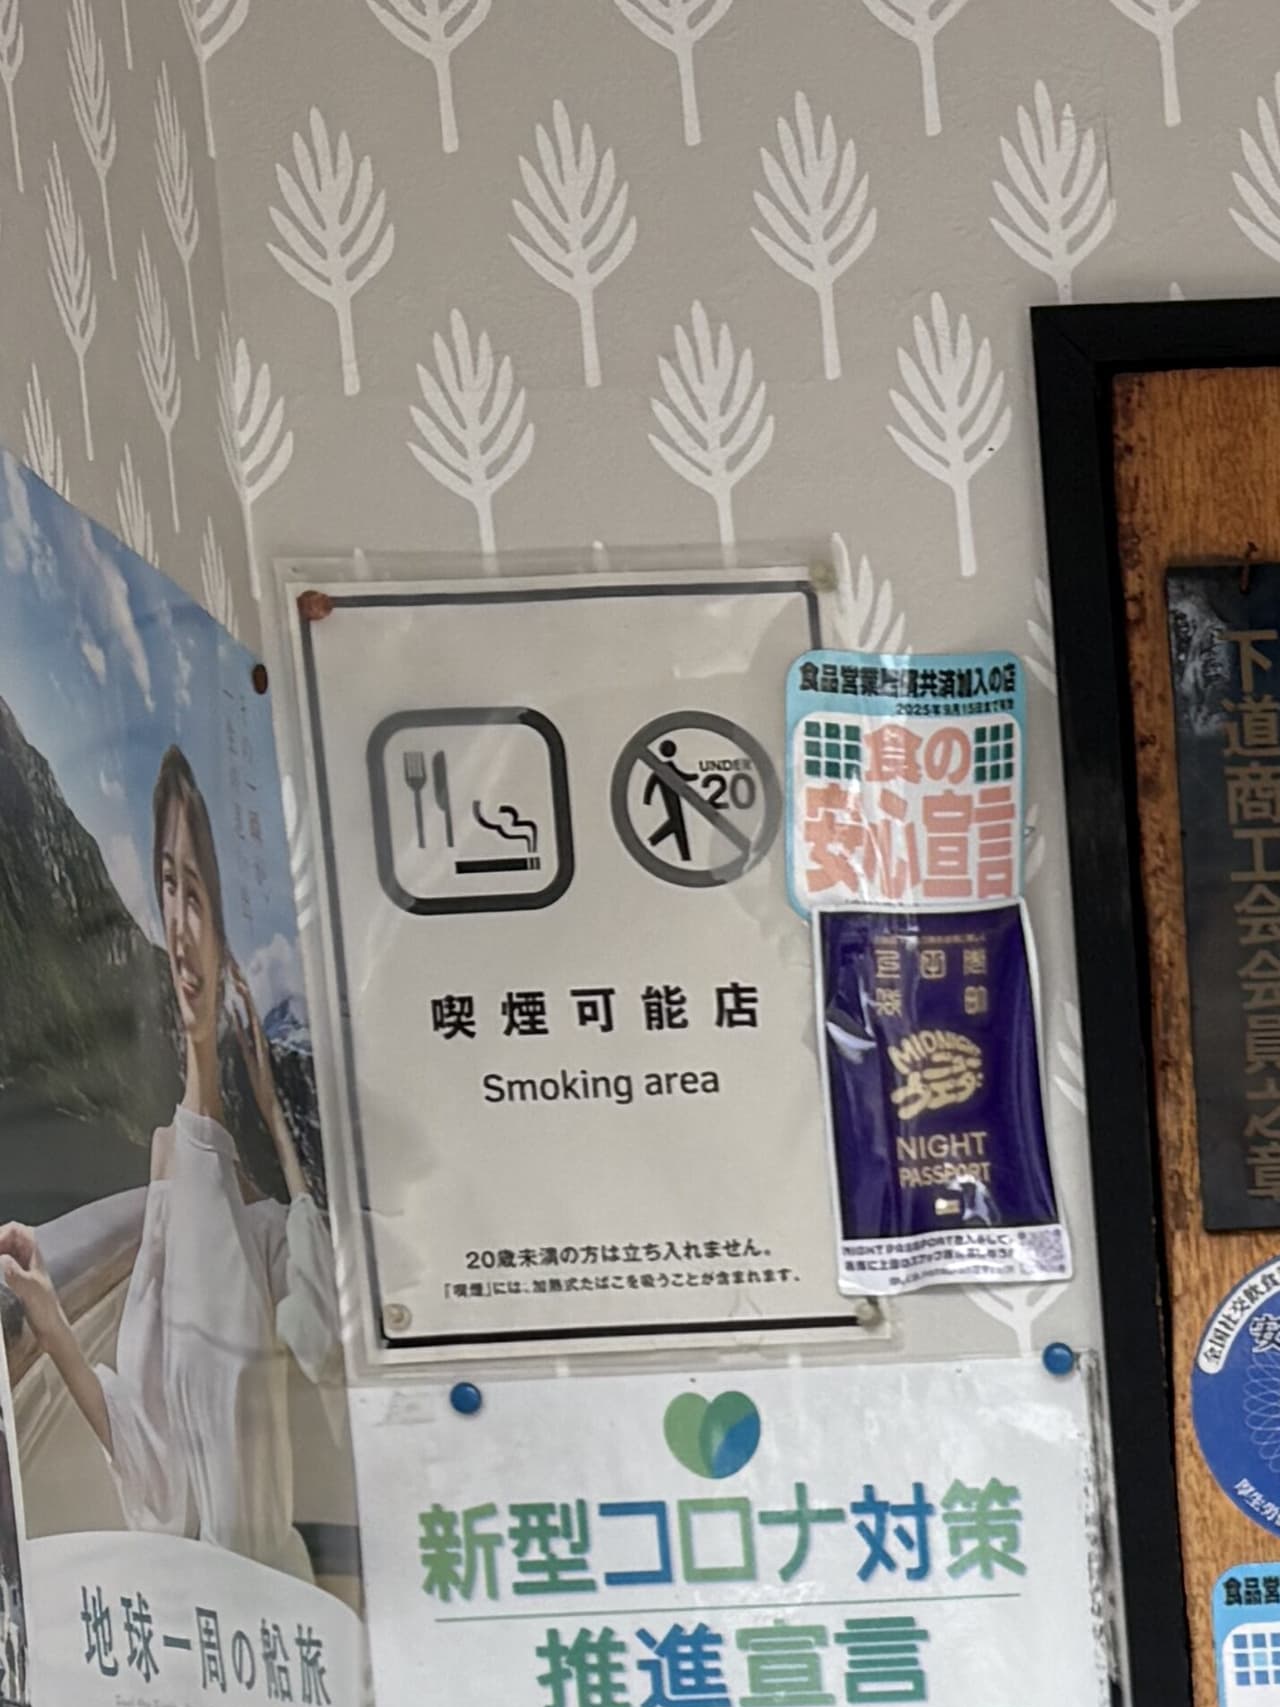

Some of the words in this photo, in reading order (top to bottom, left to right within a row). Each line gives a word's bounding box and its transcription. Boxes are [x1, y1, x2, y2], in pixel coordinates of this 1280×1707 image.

[863, 723, 972, 785] 食の
[702, 772, 757, 810] 20
[803, 783, 1016, 900] 安心宣言
[431, 982, 760, 1040] 喫煙可能店
[483, 1068, 634, 1104] Smoking
[644, 1068, 720, 1095] area
[896, 1132, 987, 1160] NIGHT
[899, 1162, 991, 1189] PASSPORT
[466, 1239, 772, 1270] 20歳未満の方は立ち入れません。
[418, 1477, 1028, 1602] 新型コロナ対策
[82, 1584, 332, 1707] 地球一周の船旅
